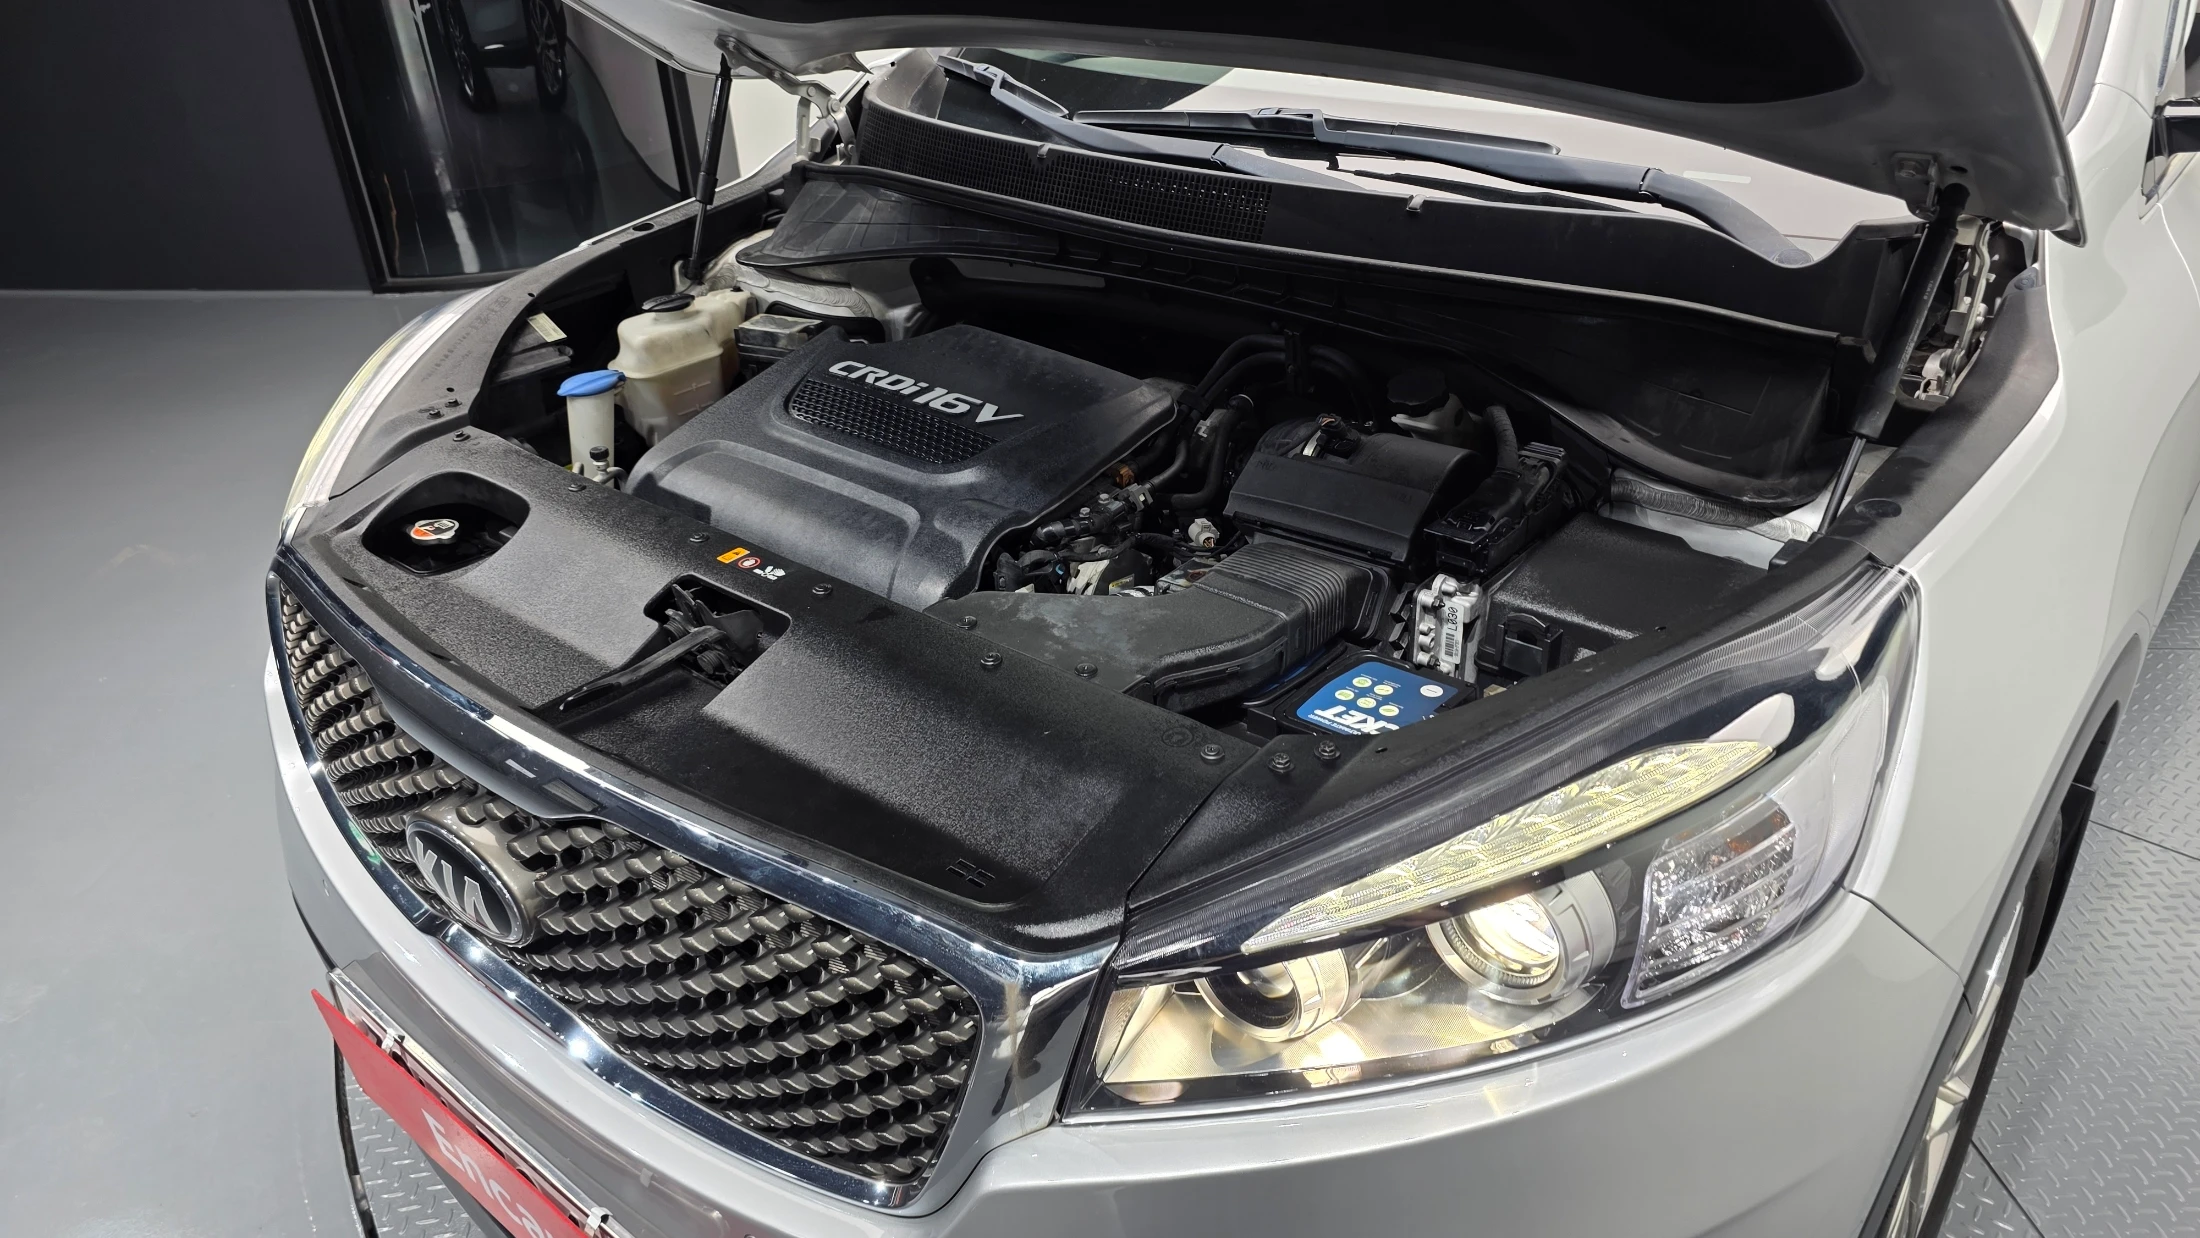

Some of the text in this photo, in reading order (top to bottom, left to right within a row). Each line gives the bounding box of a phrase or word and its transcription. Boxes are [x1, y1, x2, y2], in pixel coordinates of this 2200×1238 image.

[828, 360, 1025, 424] CRDi 16V
[415, 836, 501, 934] KIA
[421, 1108, 554, 1238] Enca
